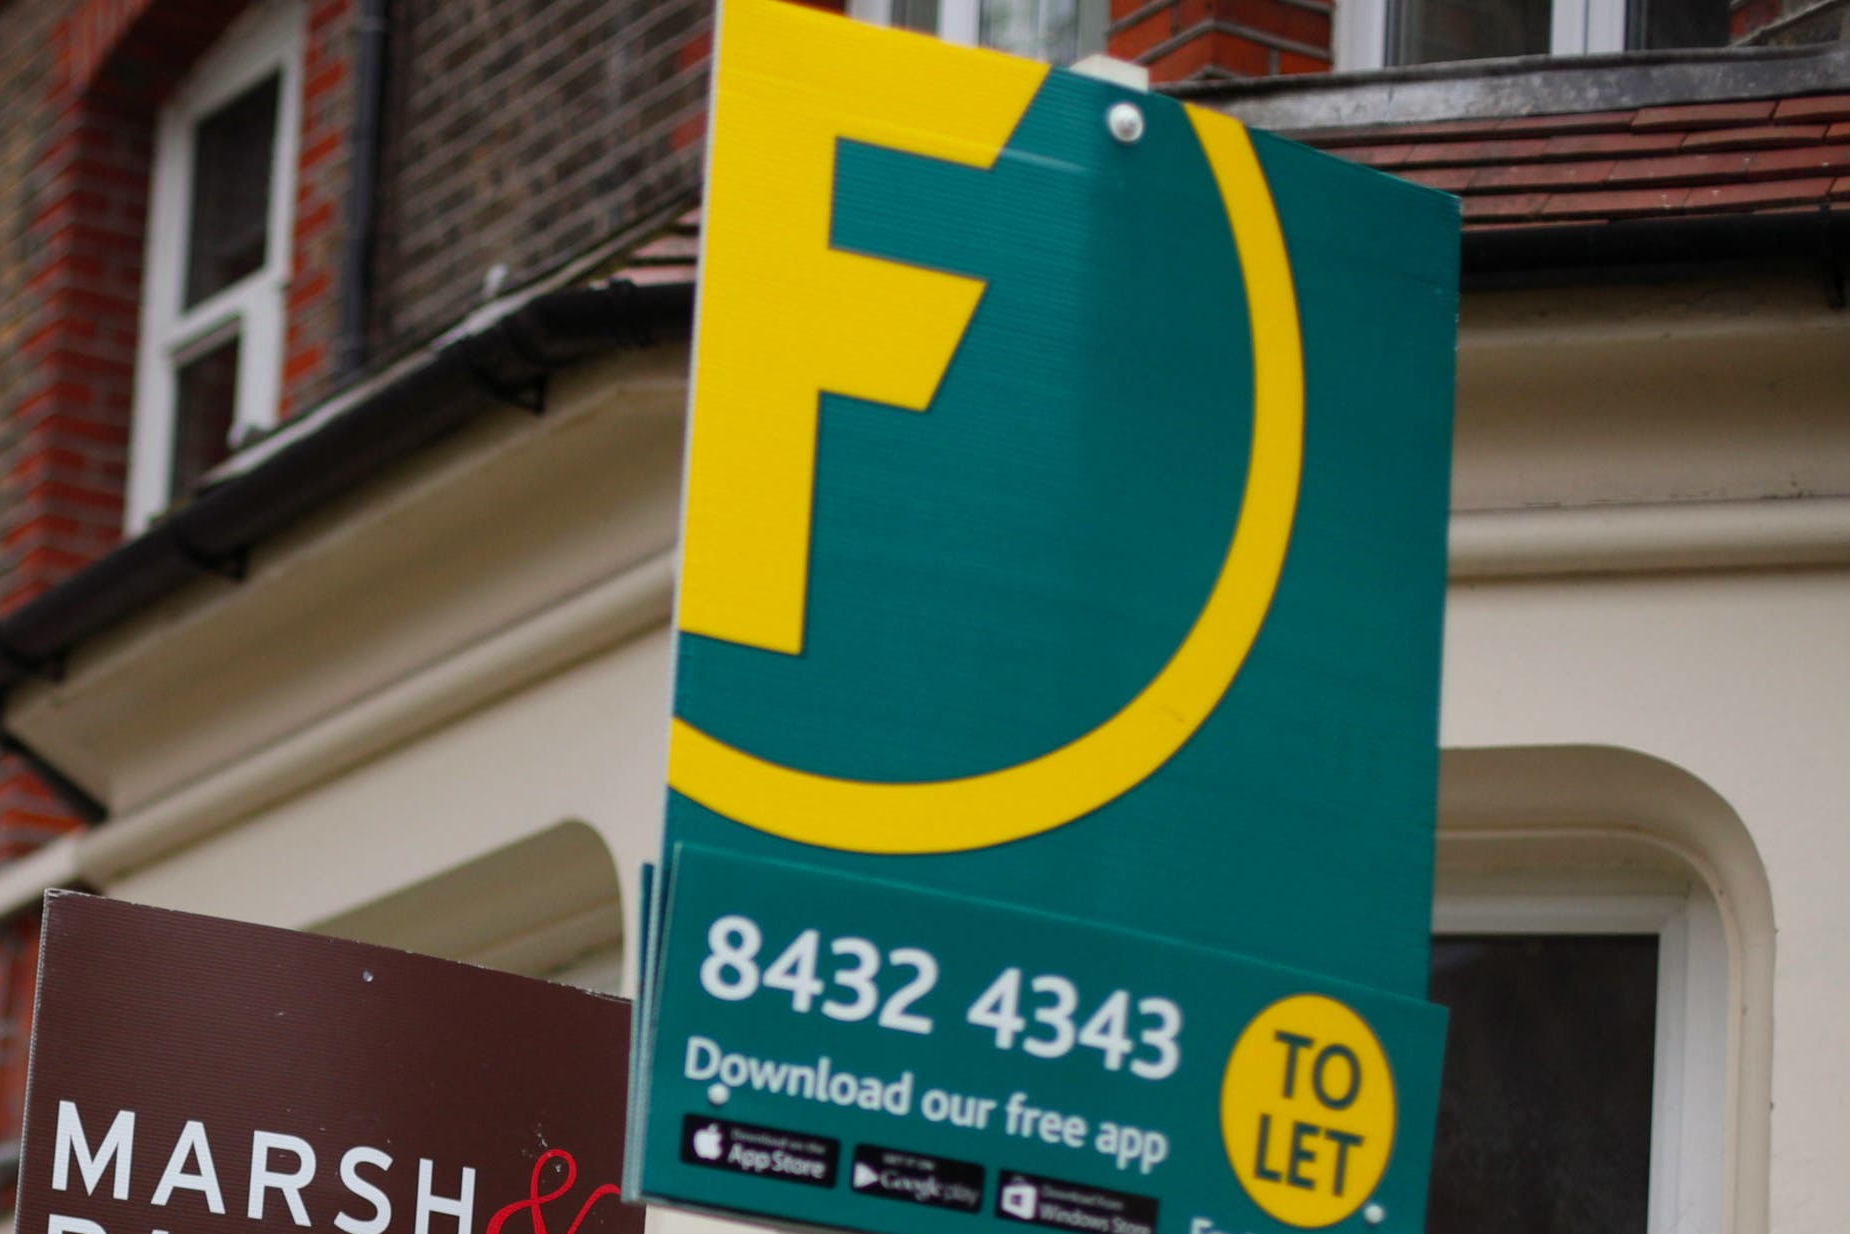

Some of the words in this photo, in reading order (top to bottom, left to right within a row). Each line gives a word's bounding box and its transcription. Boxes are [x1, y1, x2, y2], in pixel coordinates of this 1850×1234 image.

[699, 916, 938, 1035] 8432
[967, 969, 1181, 1079] 4343
[685, 1037, 910, 1116] Download
[922, 1083, 998, 1128] our
[1006, 1095, 1086, 1149] free
[1097, 1122, 1169, 1174] app
[1275, 1031, 1362, 1110] TO
[728, 1143, 771, 1172] App
[771, 1150, 827, 1179] Store
[881, 1171, 941, 1201] Google
[1255, 1113, 1365, 1197] LET
[1040, 1203, 1109, 1233] Windows
